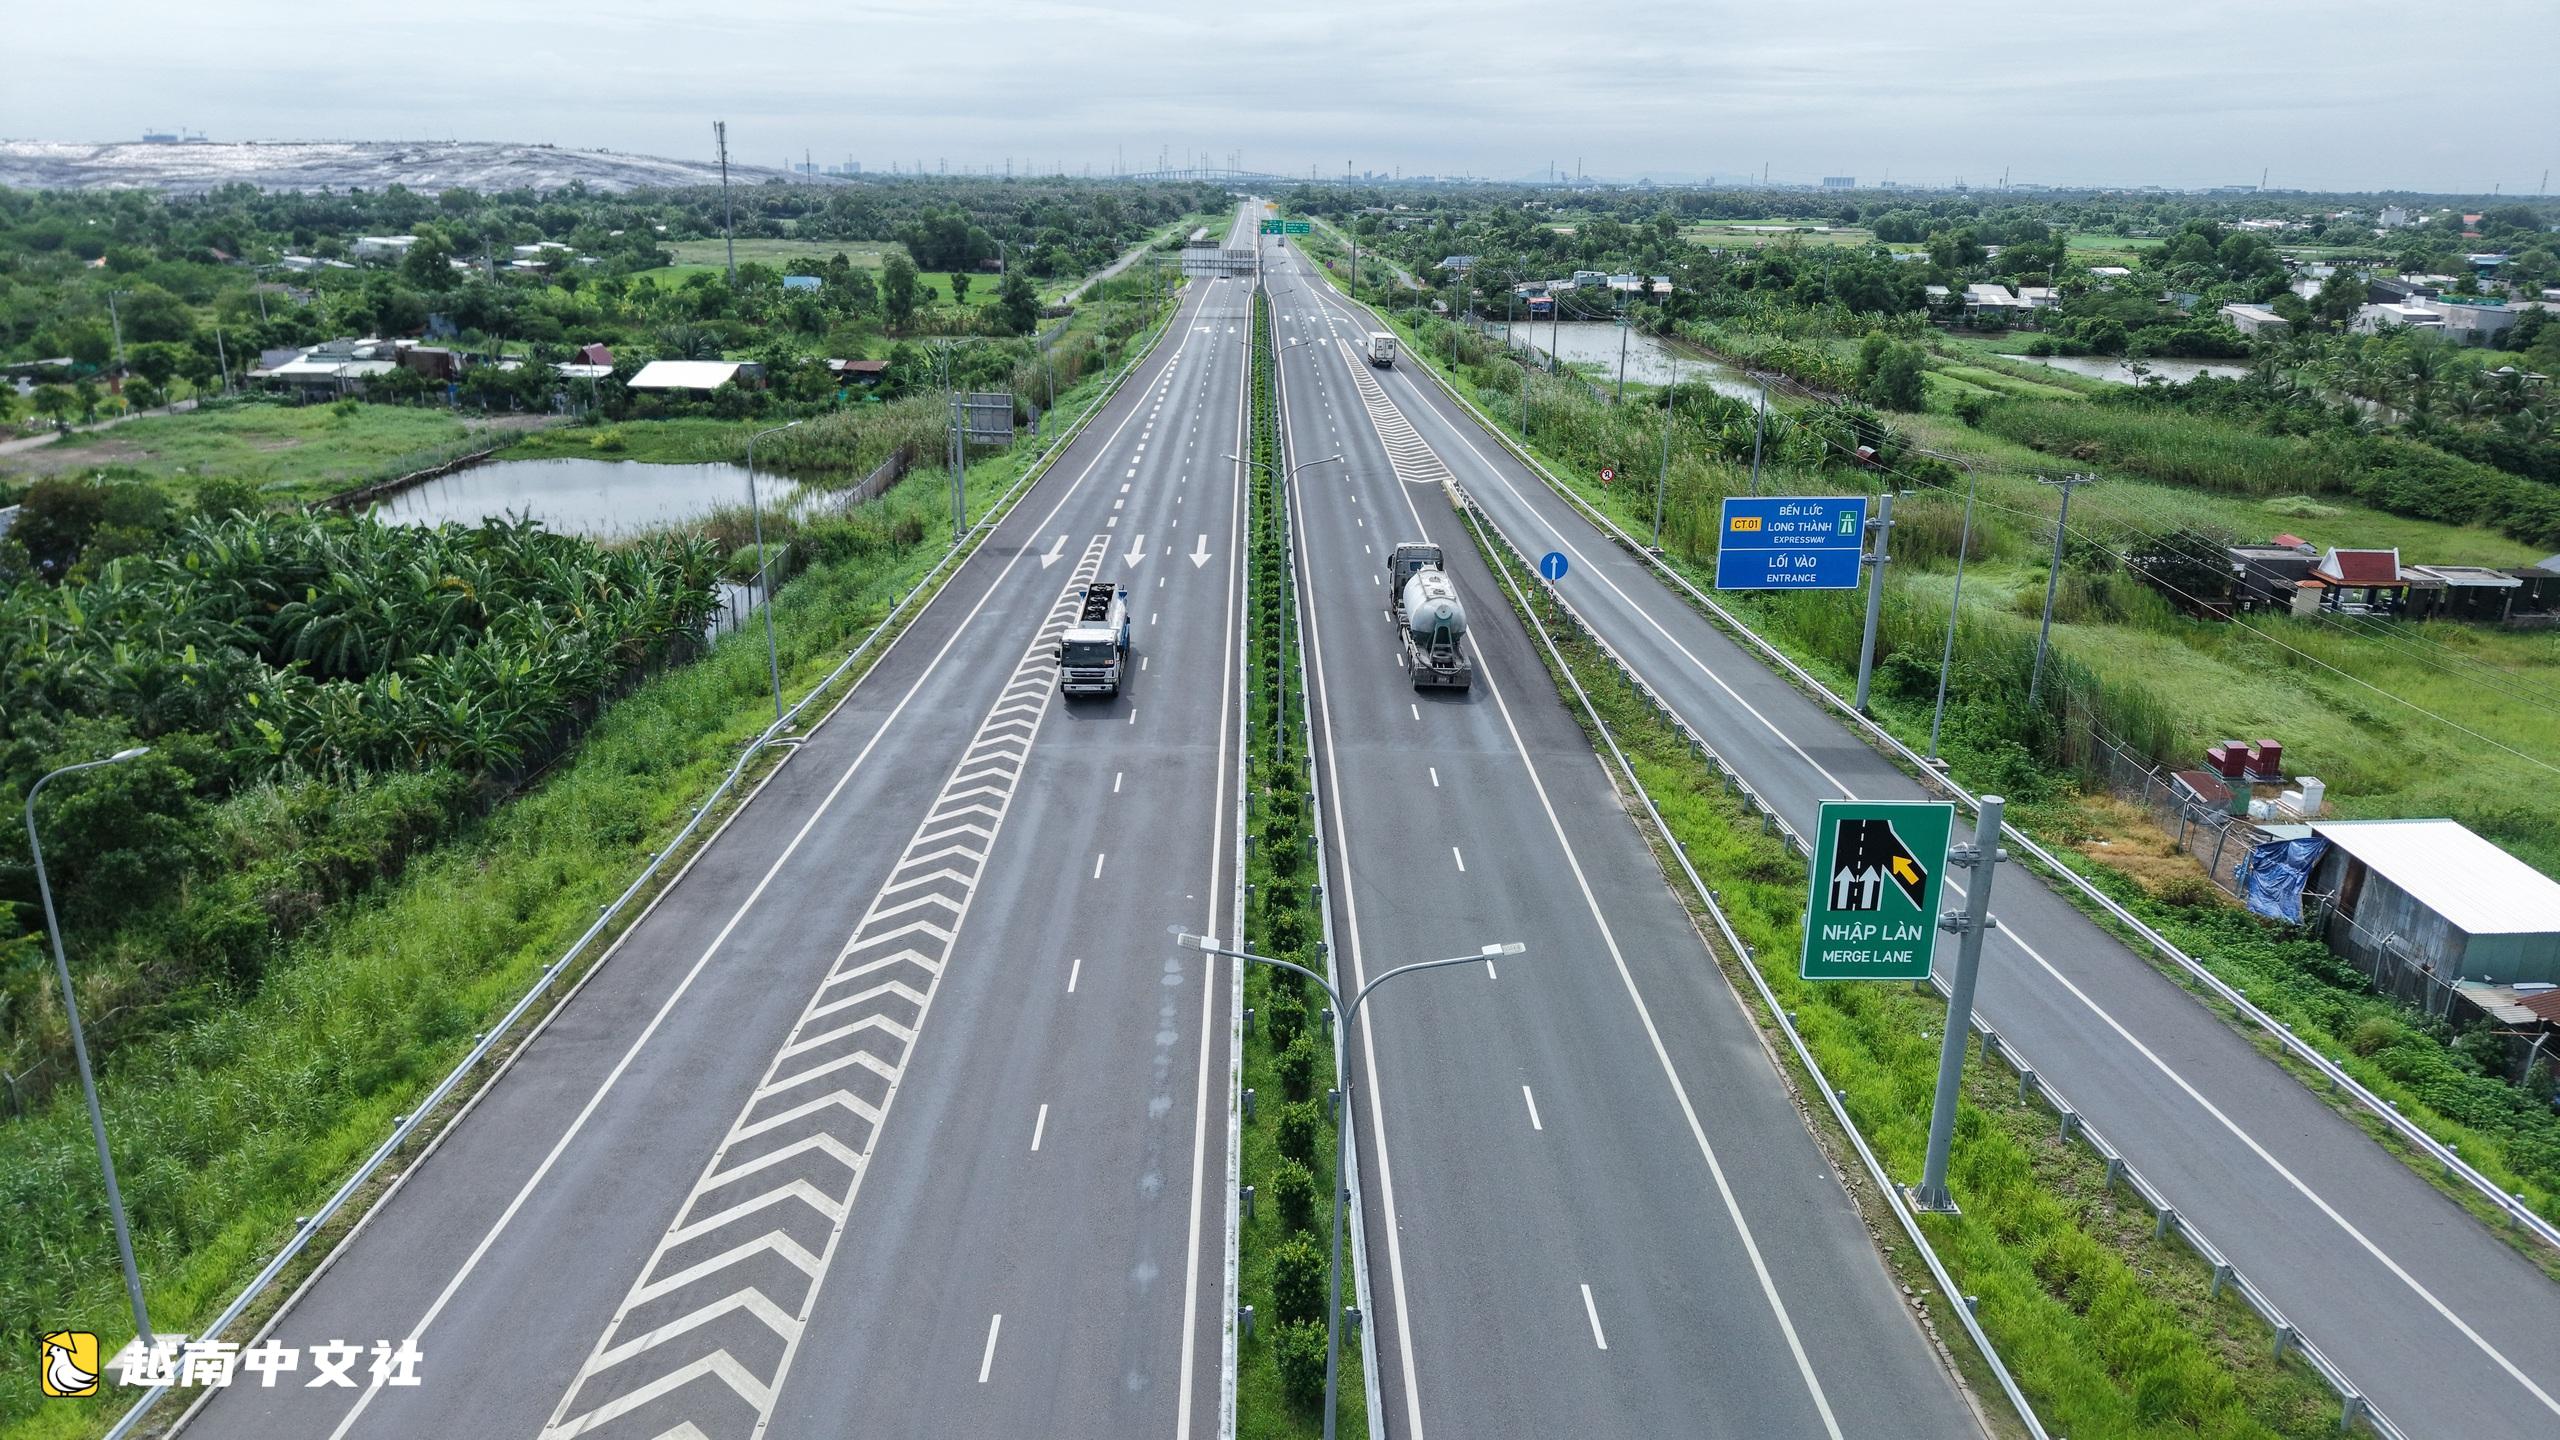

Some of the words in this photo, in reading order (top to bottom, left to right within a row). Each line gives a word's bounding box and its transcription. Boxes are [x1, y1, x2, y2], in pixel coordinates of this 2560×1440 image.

[1779, 503, 1800, 516] BẾN
[1803, 503, 1824, 516] LỨC
[1734, 519, 1758, 529] CT.01
[1768, 522, 1795, 532] LONG
[1799, 521, 1832, 532] THÀNH
[1773, 536, 1826, 544] EXPRESSWAY
[1768, 553, 1788, 568] LỐI
[1795, 553, 1817, 568] VÀO
[1766, 574, 1817, 583] ENTRANCE
[1822, 921, 1877, 944] NHẬP
[1882, 921, 1923, 941] LÀN
[1822, 950, 1870, 963] MERGE
[1873, 950, 1913, 963] LANE
